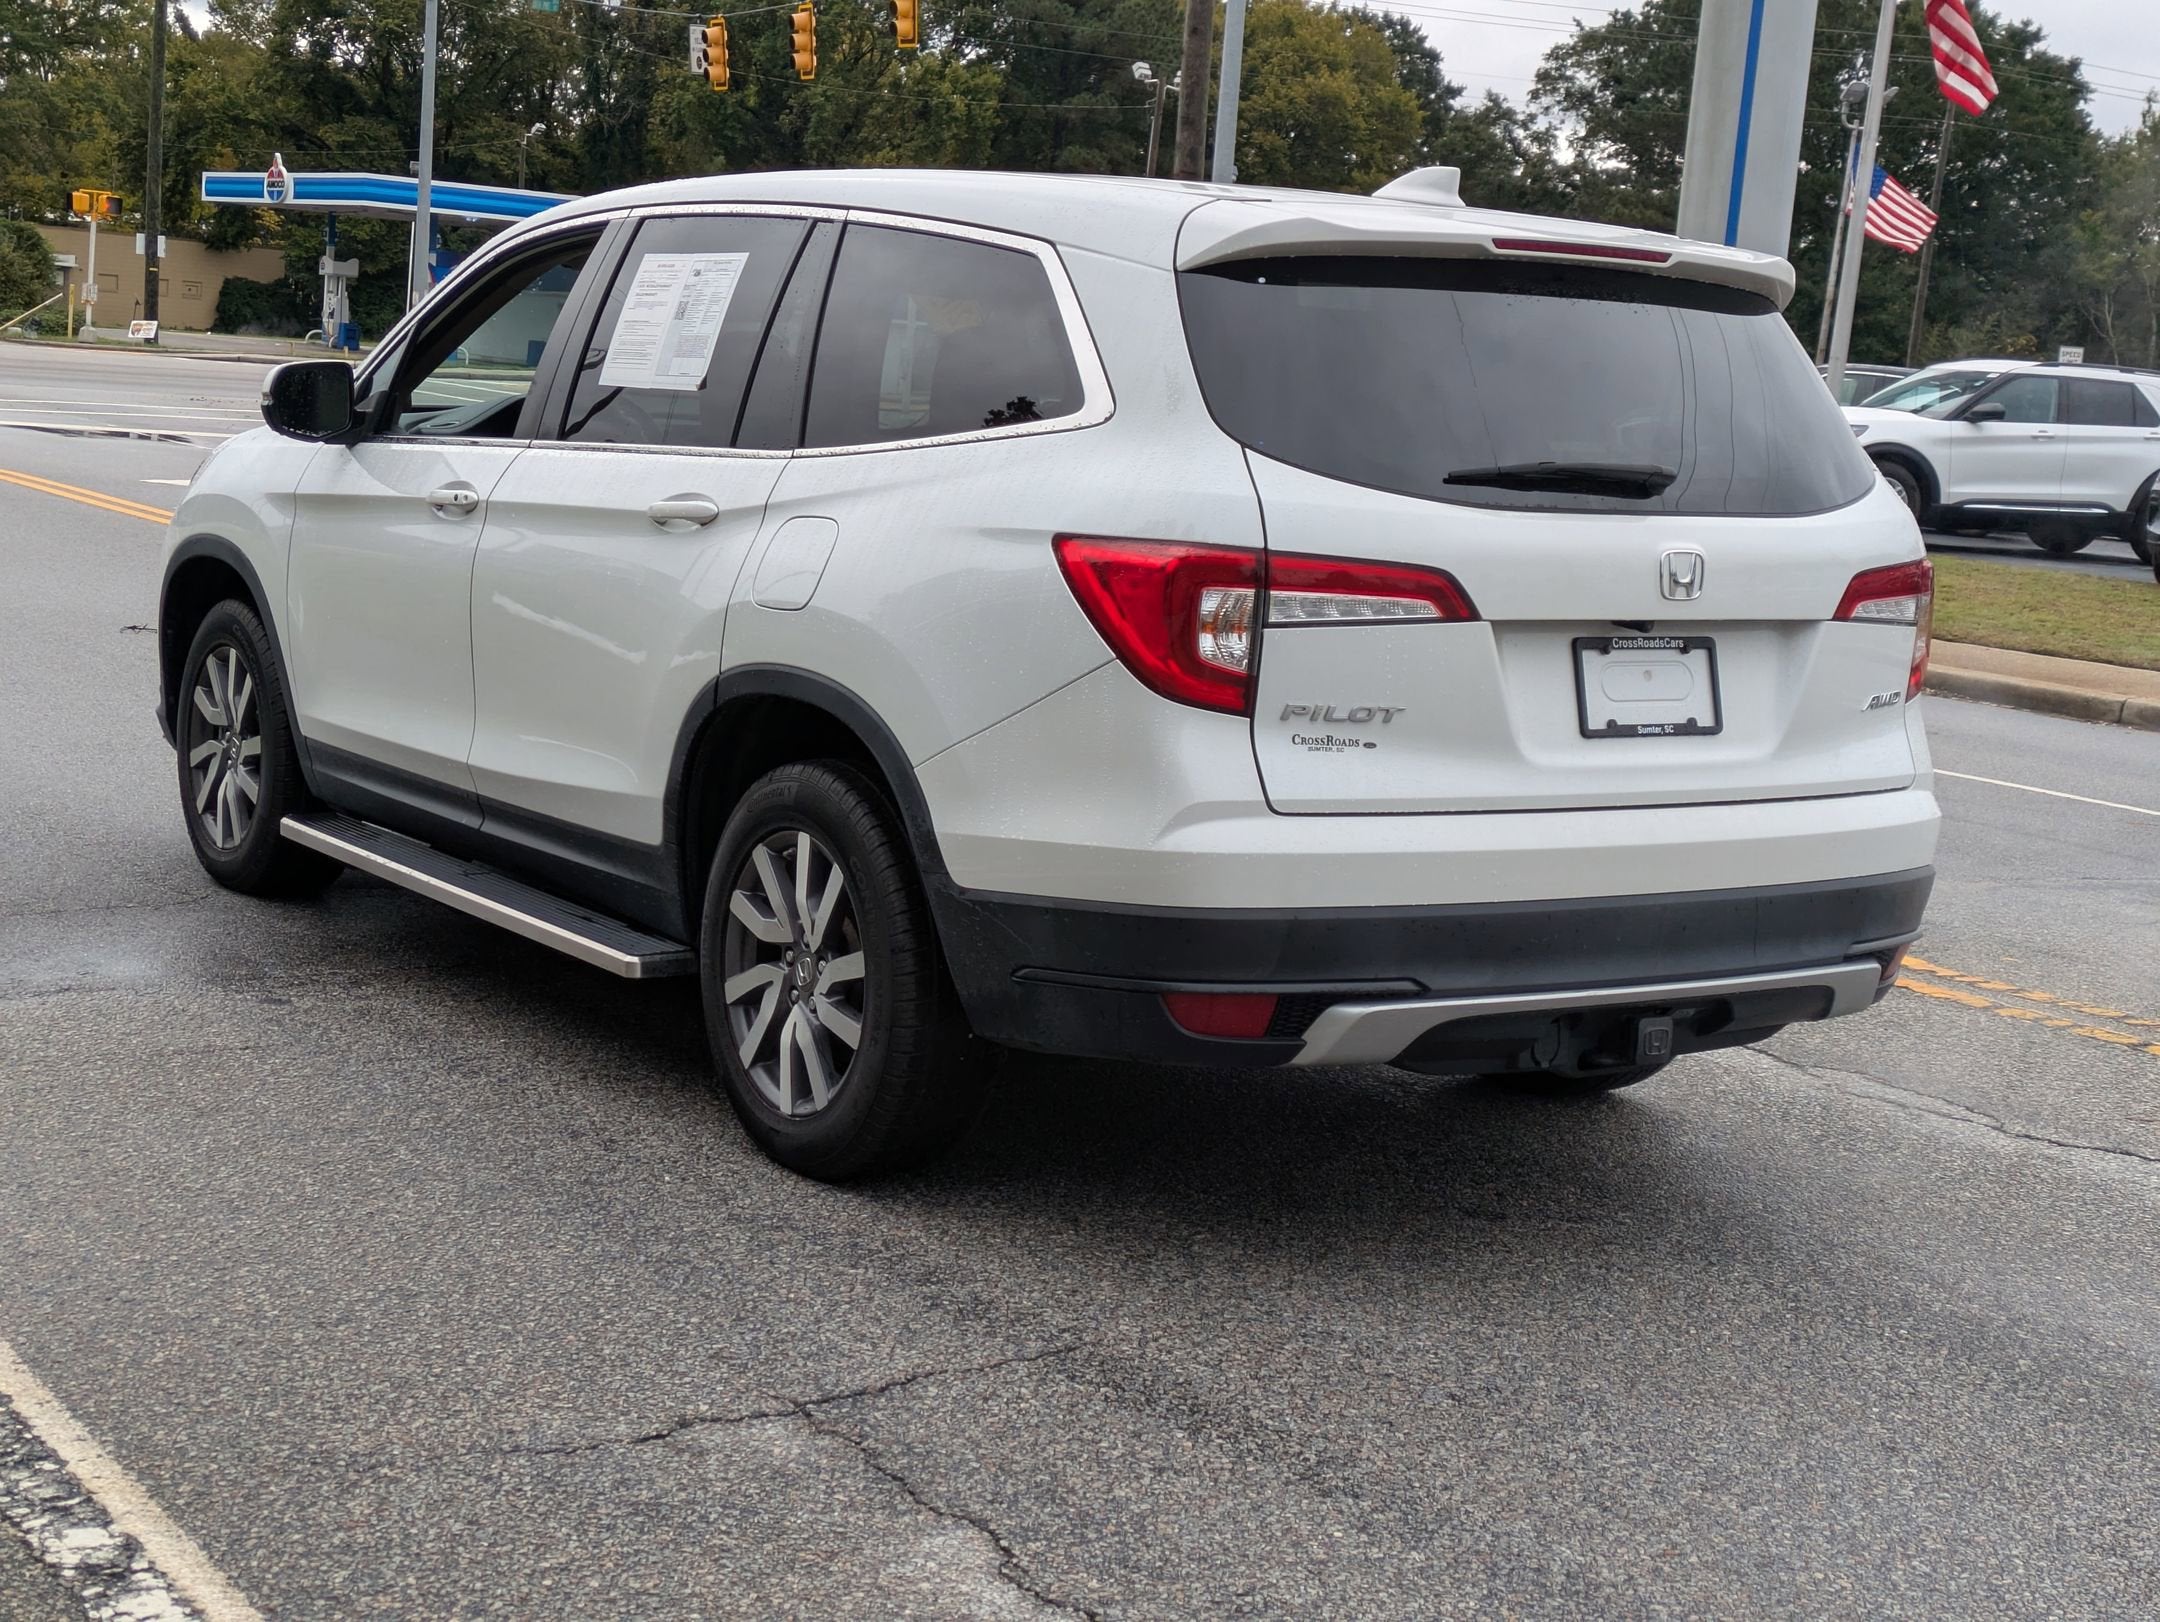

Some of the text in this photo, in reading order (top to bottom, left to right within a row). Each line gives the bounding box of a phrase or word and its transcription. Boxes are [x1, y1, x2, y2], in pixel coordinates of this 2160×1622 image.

[1612, 637, 1684, 648] CrossRoadsCars
[1861, 690, 1901, 711] AWD
[1279, 704, 1407, 724] PILOT
[1637, 724, 1674, 735] Sumter, SC
